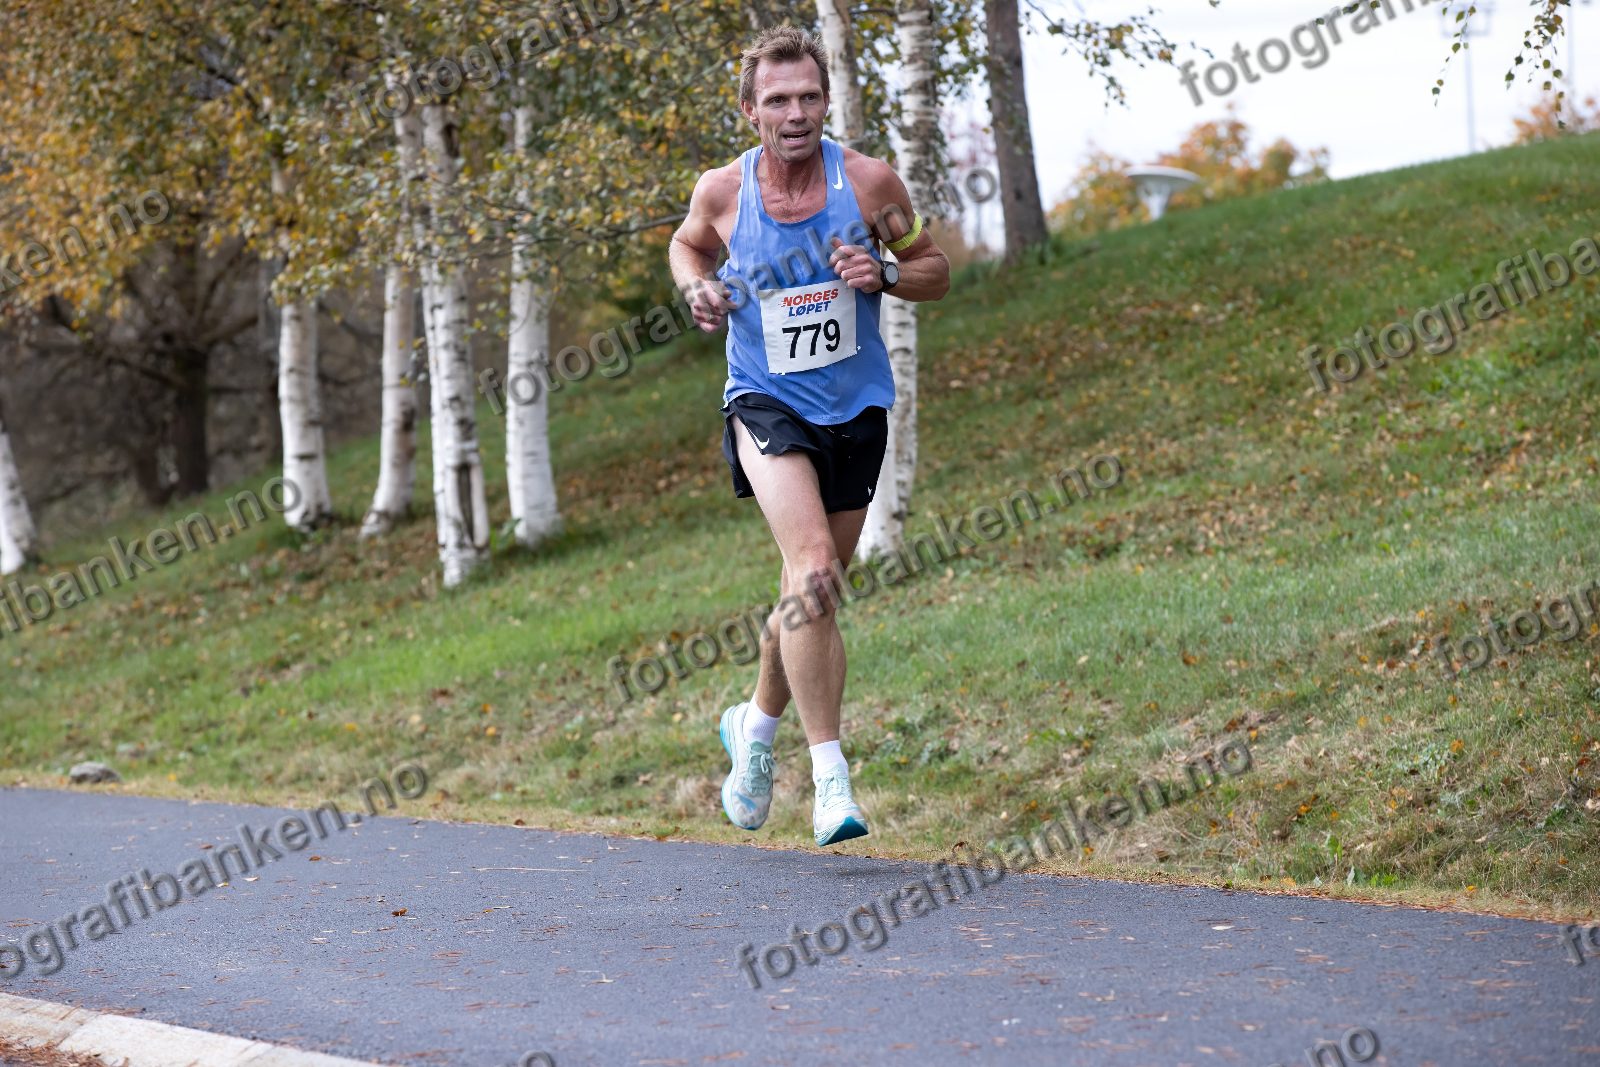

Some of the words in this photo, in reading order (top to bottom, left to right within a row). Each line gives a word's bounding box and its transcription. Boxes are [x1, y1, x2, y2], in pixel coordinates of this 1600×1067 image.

[783, 288, 839, 307] NORGES
[788, 300, 832, 317] LØPET
[782, 319, 841, 359] 779
